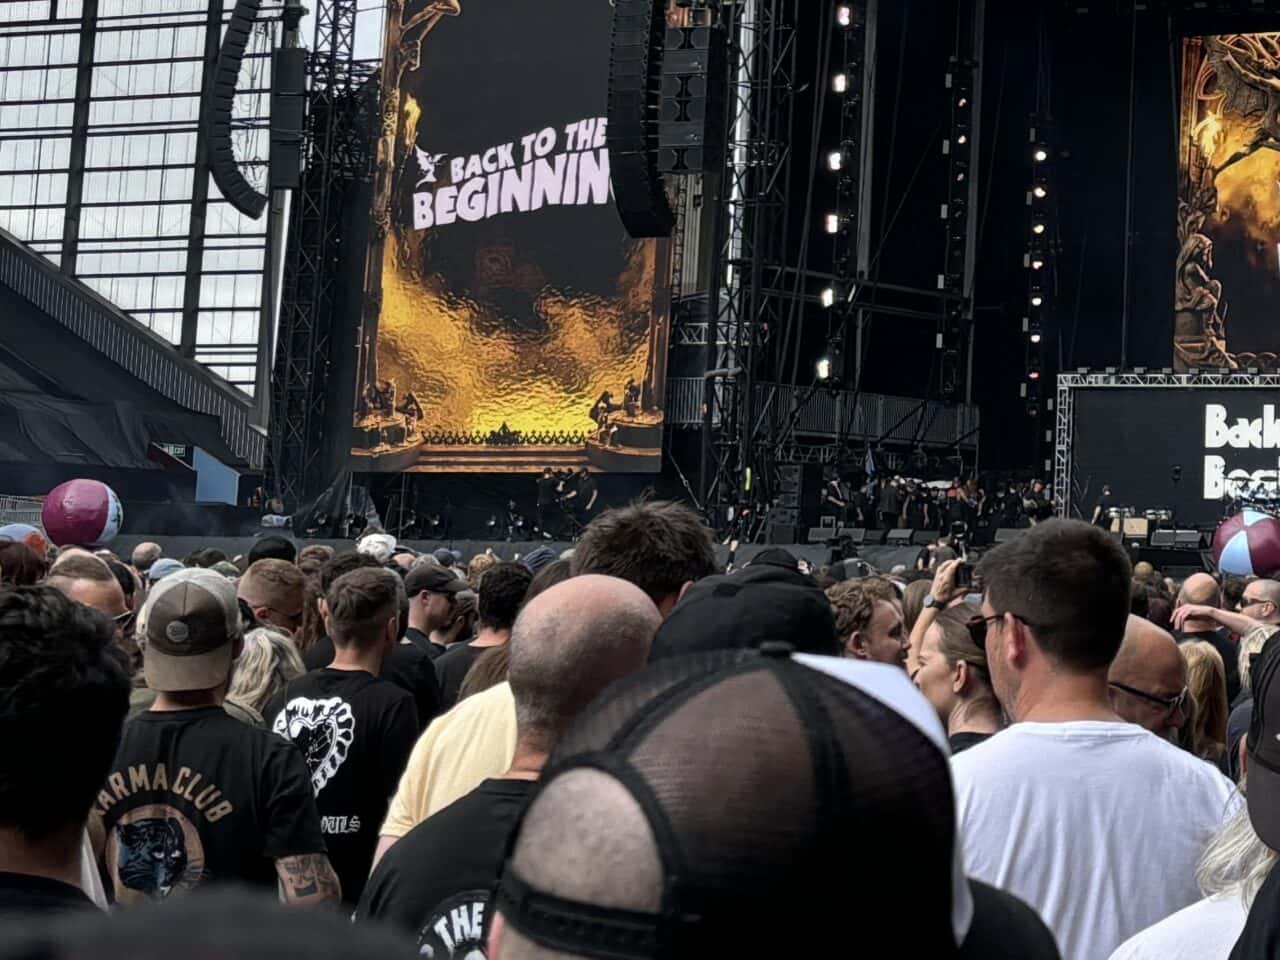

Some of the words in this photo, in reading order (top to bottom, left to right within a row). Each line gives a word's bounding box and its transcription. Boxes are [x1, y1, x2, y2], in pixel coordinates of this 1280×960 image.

[450, 143, 514, 182] BACK
[520, 127, 558, 164] TO
[565, 117, 608, 151] THE
[412, 148, 615, 230] BEGINNIN
[95, 762, 169, 817] ARMA
[171, 765, 234, 823] CLUB
[320, 815, 361, 834] OULS
[433, 902, 485, 954] THE
